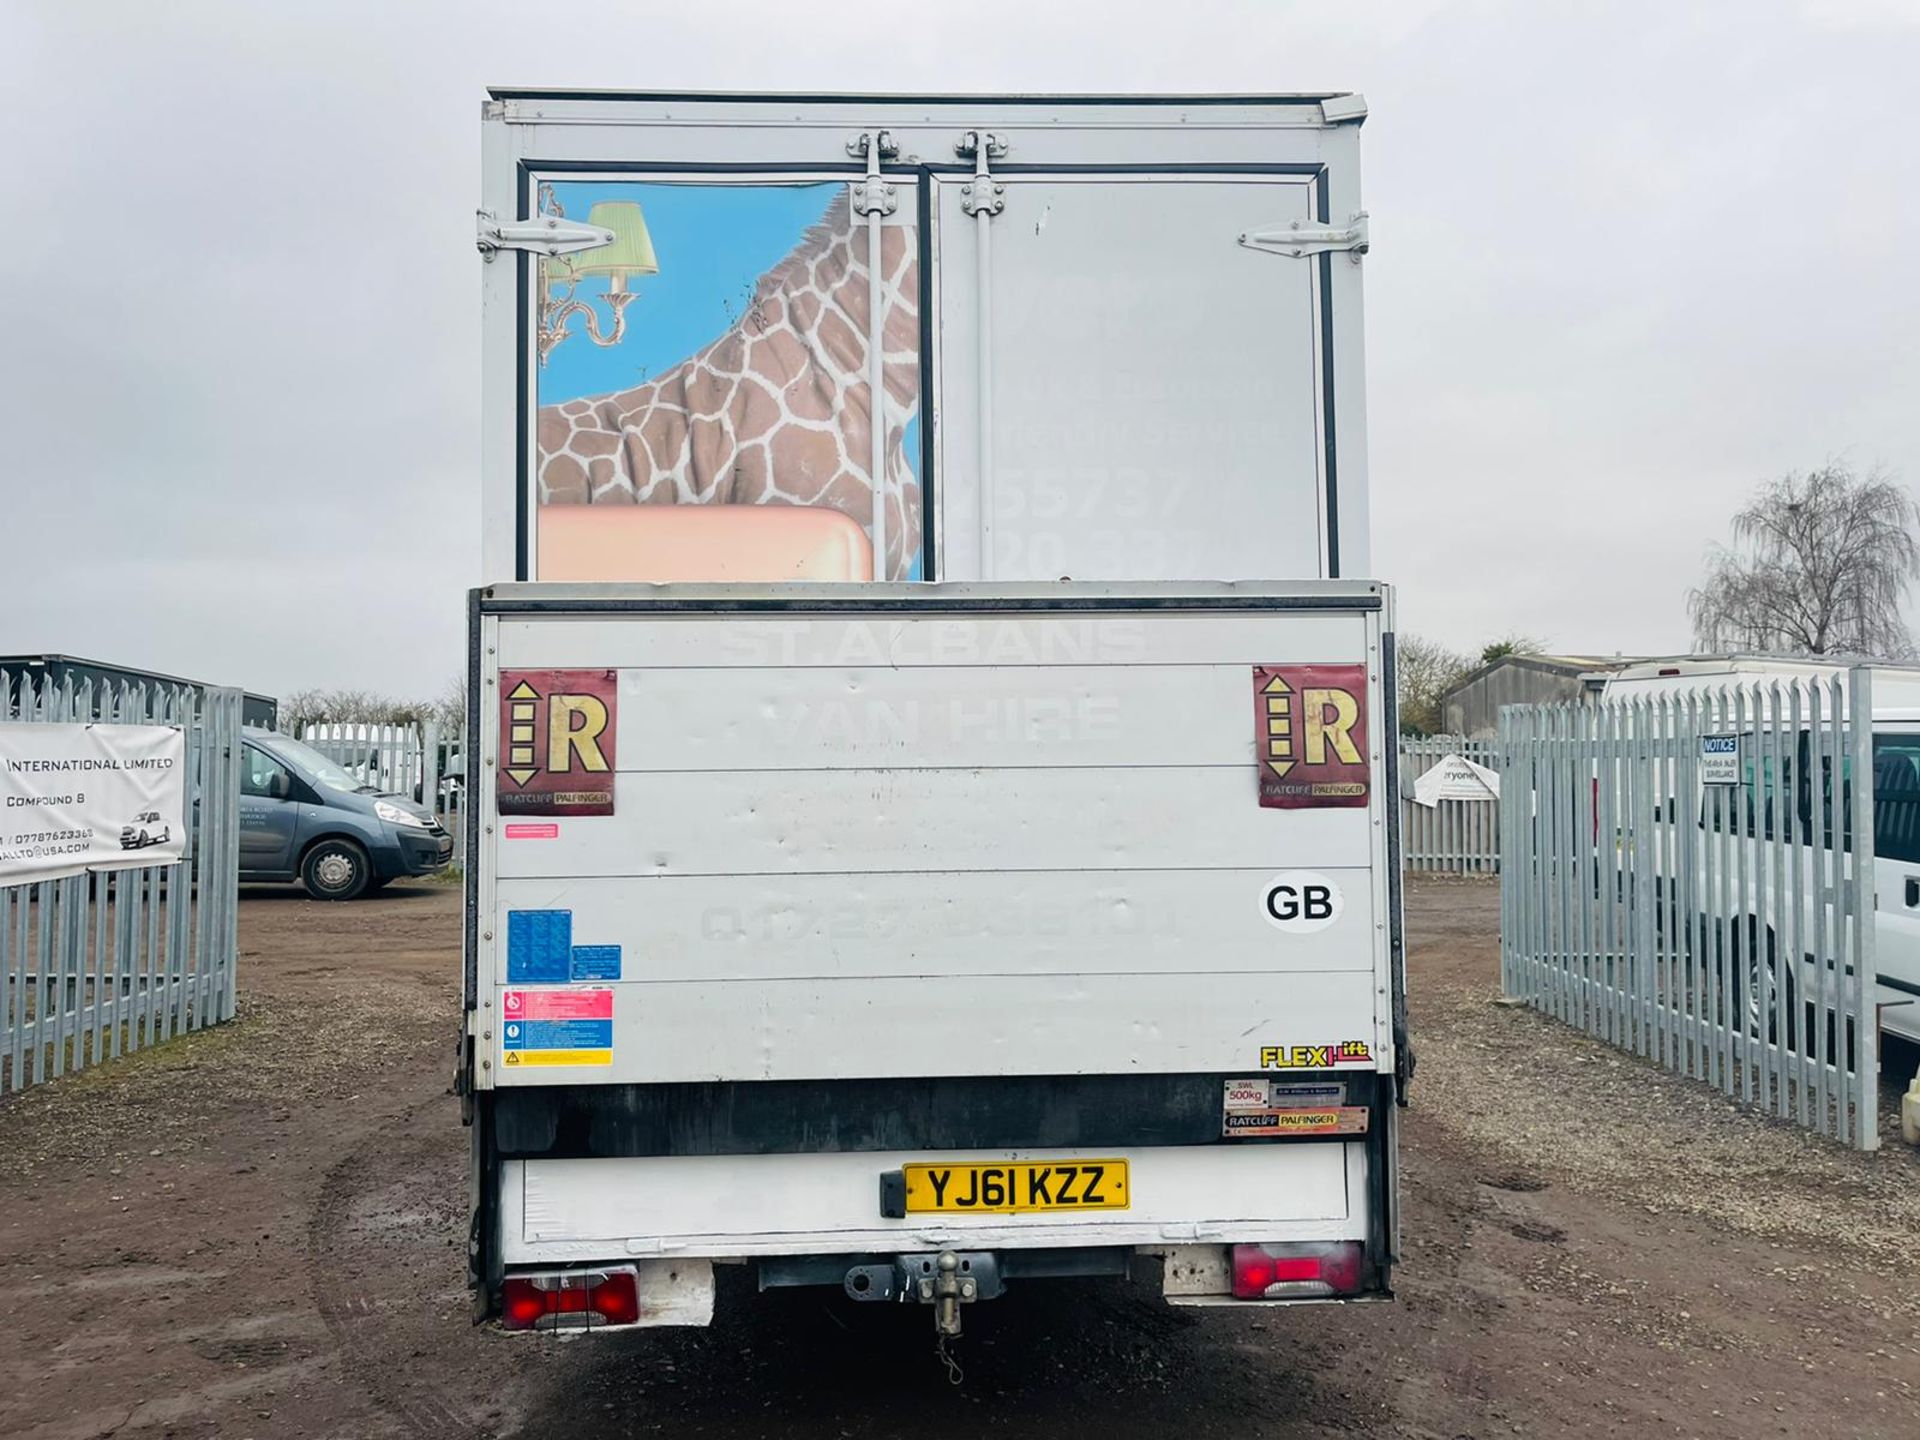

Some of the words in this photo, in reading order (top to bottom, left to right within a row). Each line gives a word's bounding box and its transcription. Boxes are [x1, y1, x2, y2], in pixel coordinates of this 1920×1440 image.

[948, 695, 1121, 742] HIRE
[1301, 687, 1364, 766] R
[547, 692, 613, 774] R
[1704, 738, 1735, 752] NOTICE
[6, 758, 121, 772] INTERNATIONAL
[123, 758, 173, 770] LIMITED
[7, 794, 73, 807] COMPOUND
[0, 843, 90, 861] ALLTD@USA.COM
[1266, 885, 1333, 920] GB
[1229, 1090, 1262, 1101] 500kg
[1229, 1115, 1278, 1126] RATCLIFF
[1280, 1114, 1334, 1125] PALFINGER
[928, 1168, 1016, 1207] YJ61
[1029, 1166, 1105, 1204] KZZ
